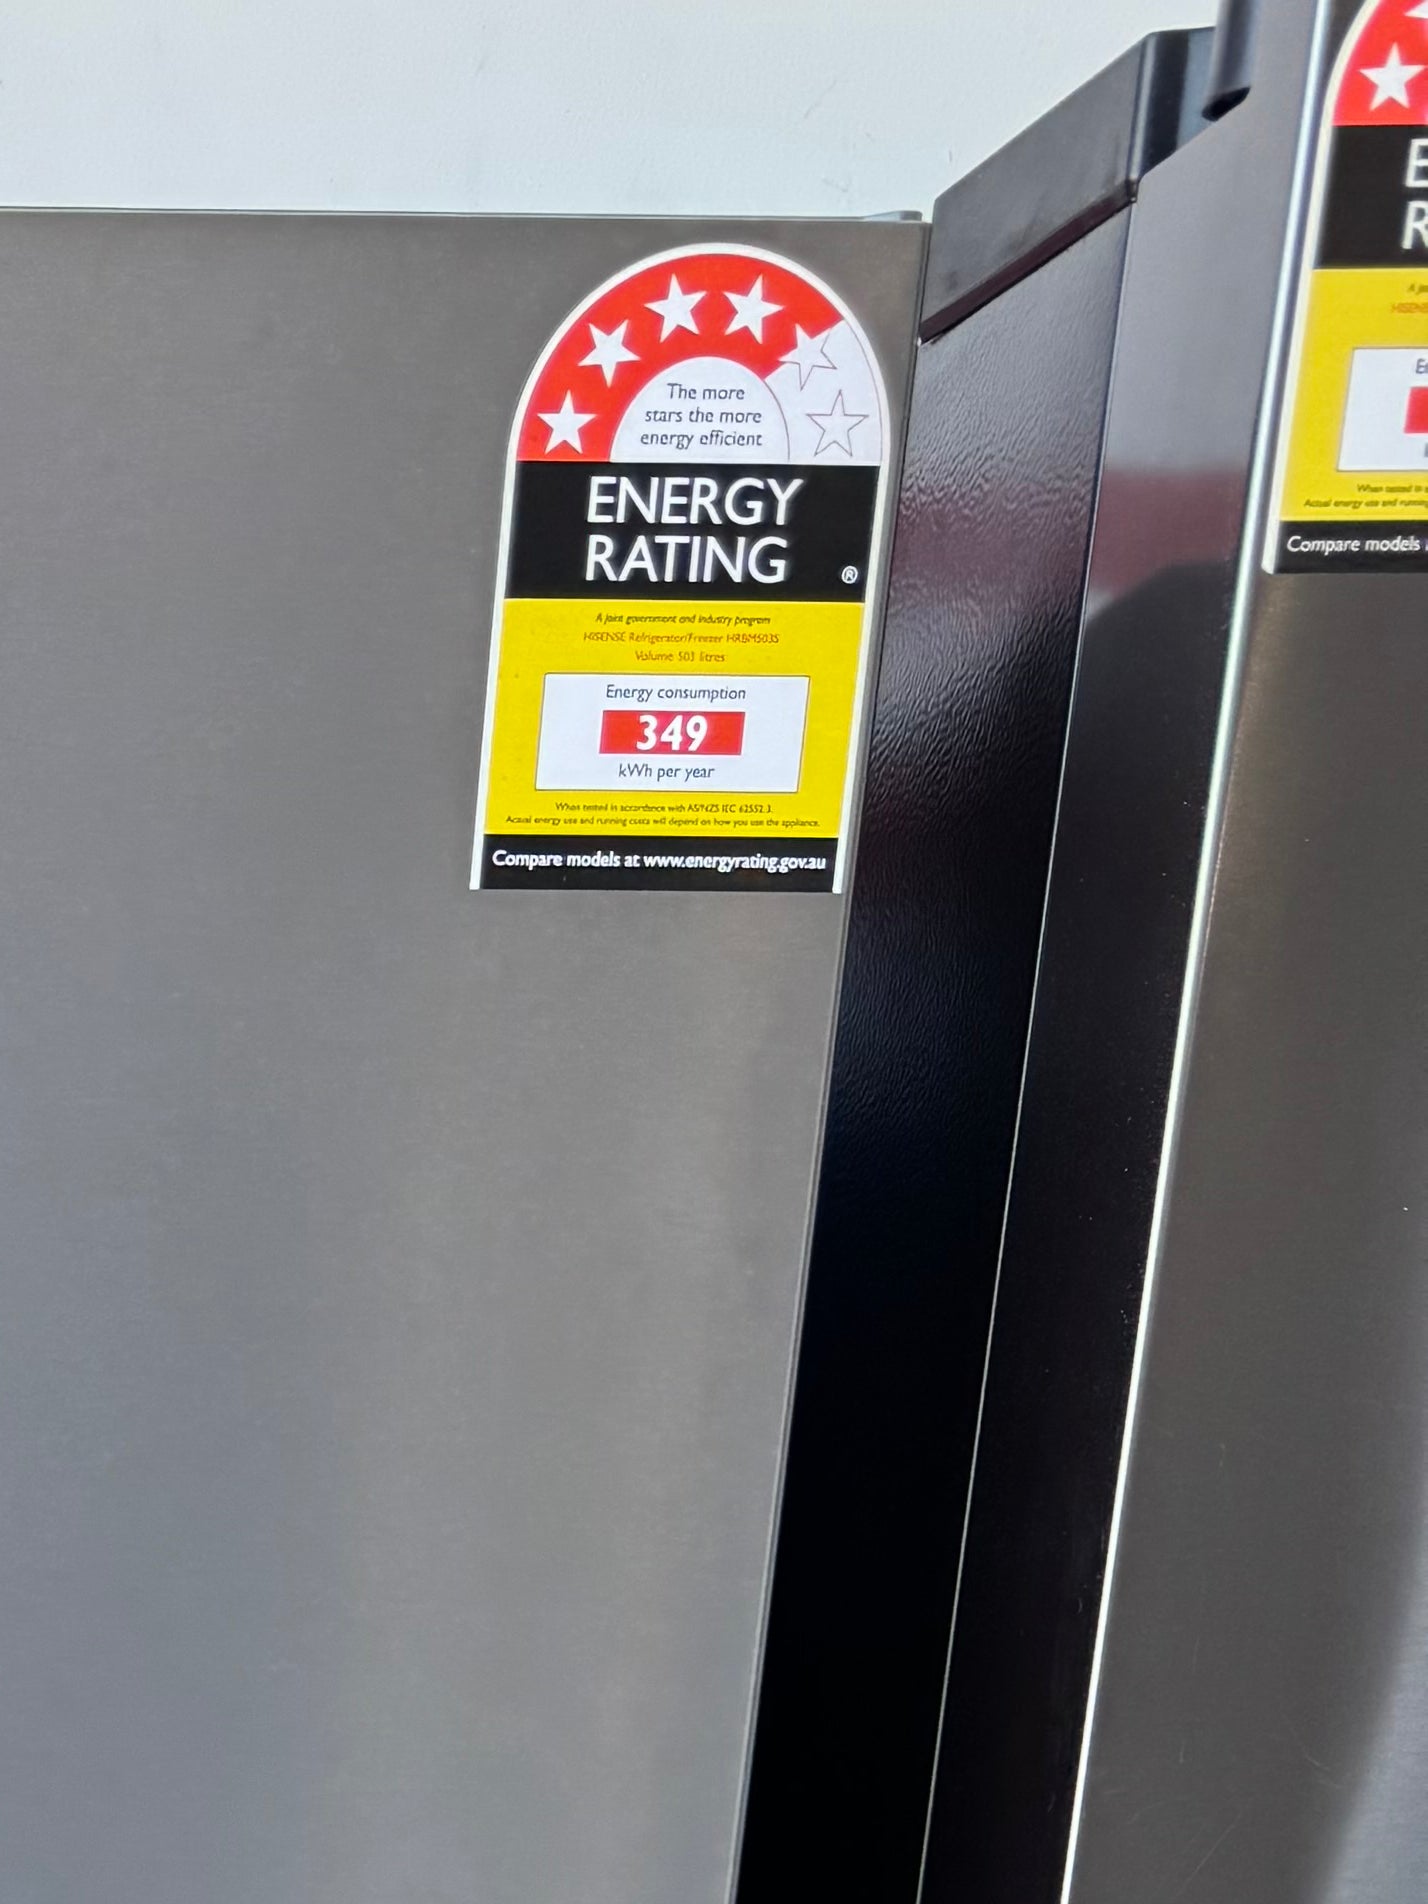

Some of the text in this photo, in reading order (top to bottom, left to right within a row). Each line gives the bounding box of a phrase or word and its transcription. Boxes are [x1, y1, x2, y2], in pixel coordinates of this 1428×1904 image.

[667, 382, 746, 400] The more
[644, 406, 762, 423] stars the more
[640, 429, 763, 450] energy efficient
[587, 475, 804, 526] ENERGY
[1286, 535, 1421, 556] Compare models
[585, 534, 788, 584] RATING
[635, 650, 675, 662] Volume
[606, 683, 747, 703] Energy consumption
[635, 714, 709, 752] 349
[618, 763, 716, 783] kWh per year
[492, 850, 827, 874] Compare models at www.energyrating.gov.au
